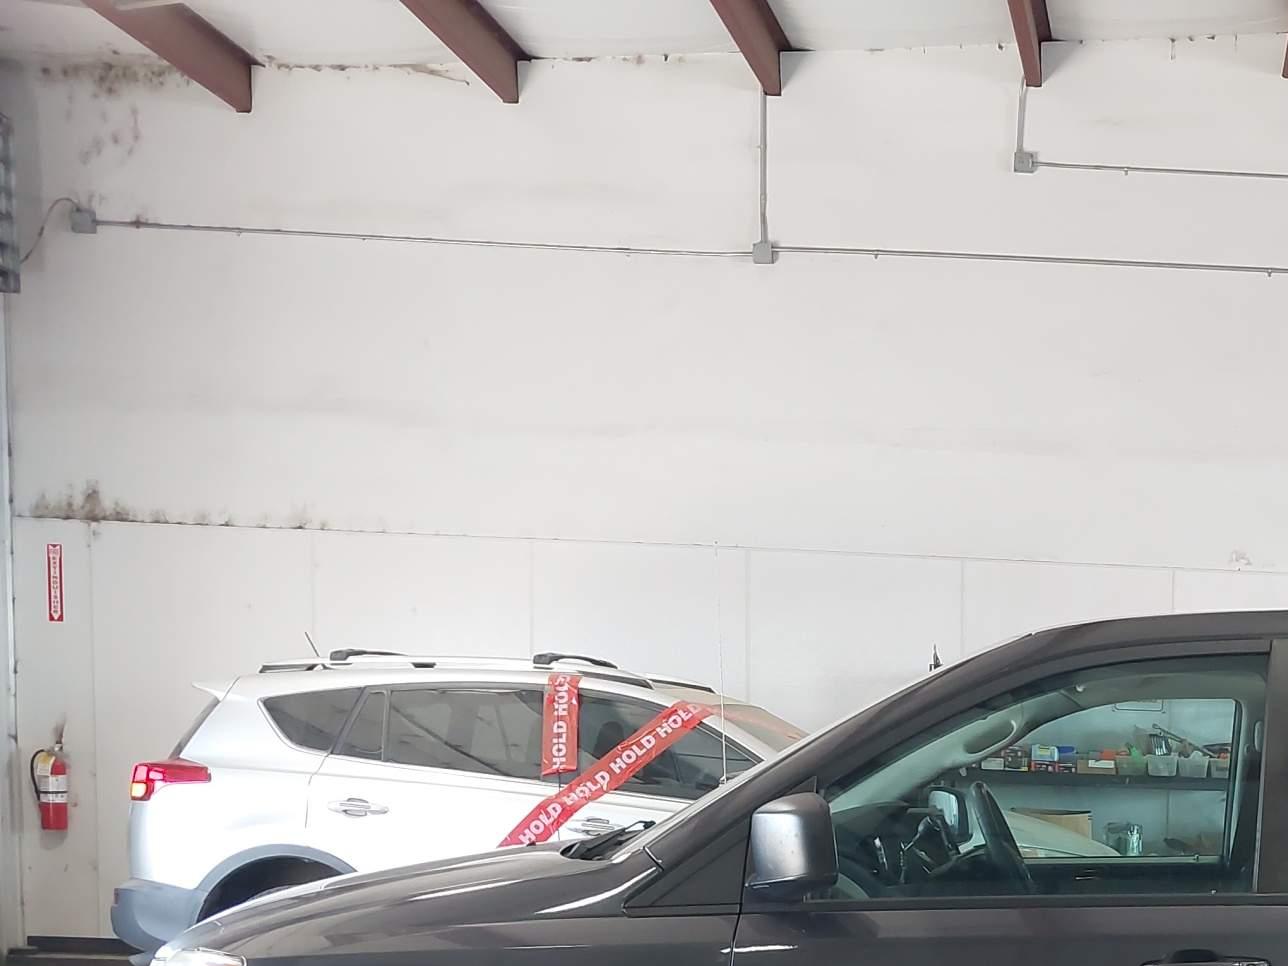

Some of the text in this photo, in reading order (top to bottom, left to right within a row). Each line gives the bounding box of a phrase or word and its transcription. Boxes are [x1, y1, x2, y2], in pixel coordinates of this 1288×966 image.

[518, 802, 563, 844] HOLD
[609, 735, 656, 774] HOLD
[656, 704, 702, 738] HOLD
[552, 720, 568, 769] HOLD
